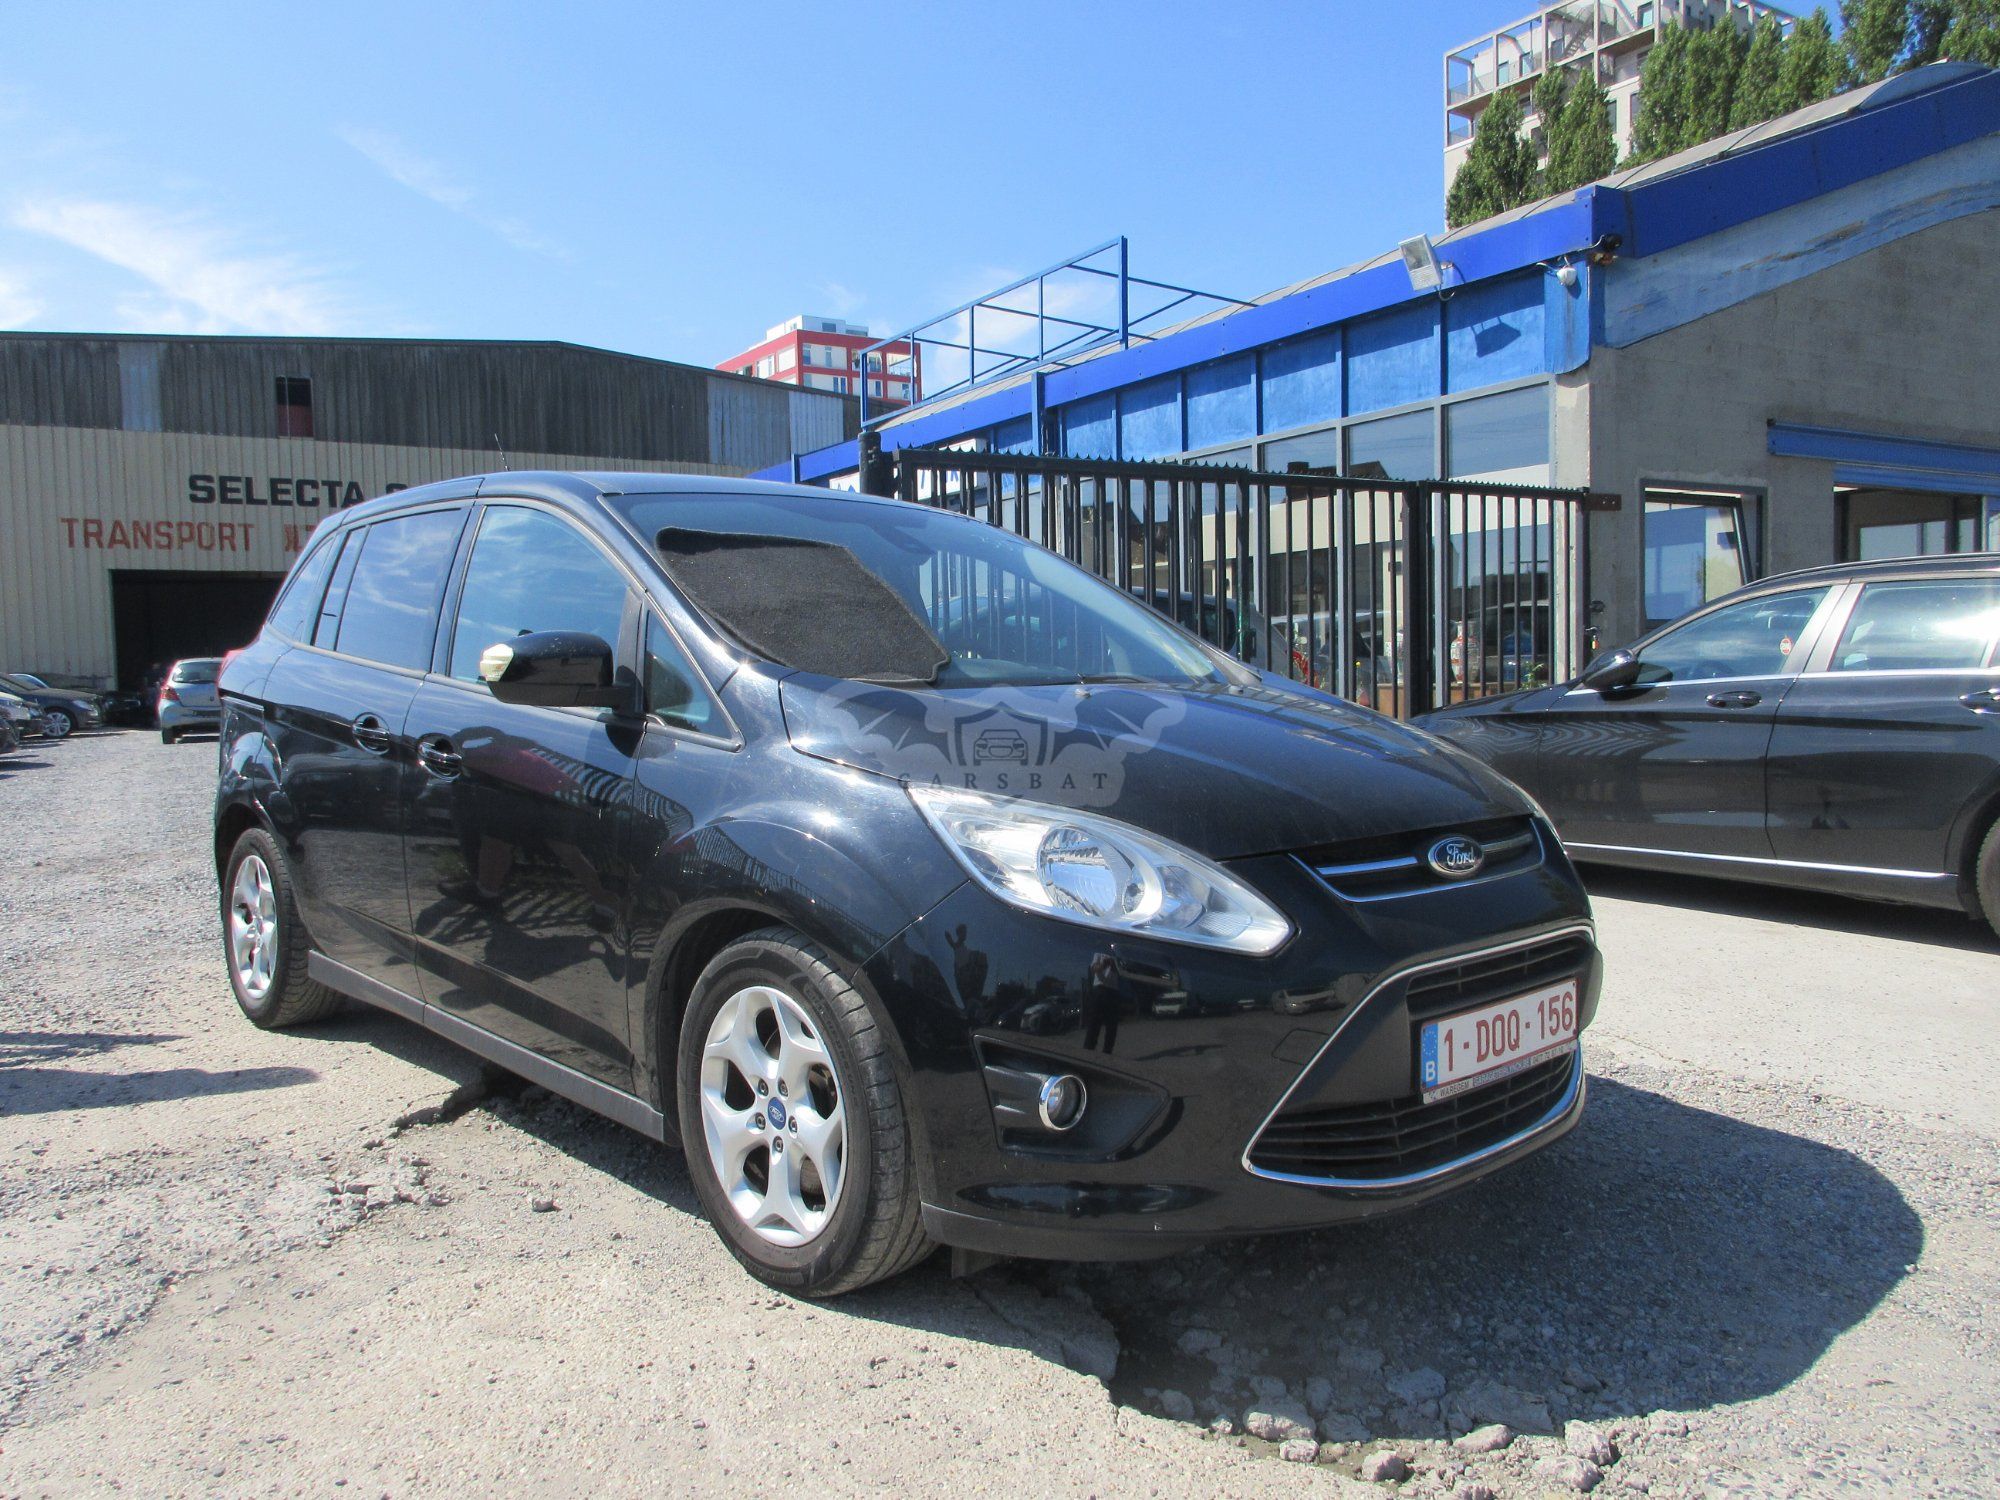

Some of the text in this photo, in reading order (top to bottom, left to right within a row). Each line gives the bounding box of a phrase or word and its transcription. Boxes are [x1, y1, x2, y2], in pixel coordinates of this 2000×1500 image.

[189, 474, 365, 509] SELECTA
[60, 517, 255, 551] TRANSPORT
[1446, 842, 1477, 867] Ford
[1444, 991, 1574, 1072] 1-DOQ-156
[1425, 1060, 1437, 1083] B
